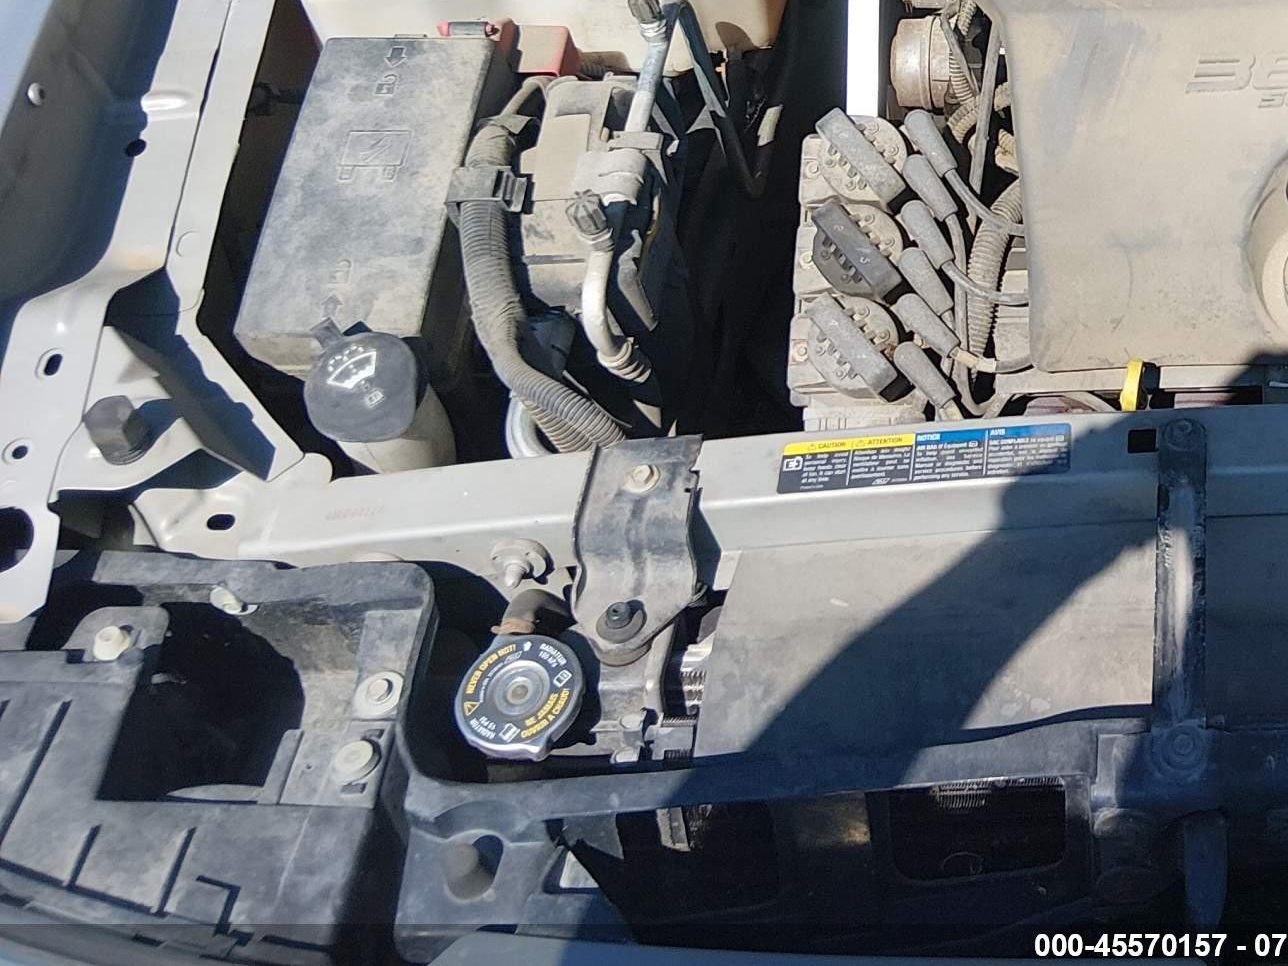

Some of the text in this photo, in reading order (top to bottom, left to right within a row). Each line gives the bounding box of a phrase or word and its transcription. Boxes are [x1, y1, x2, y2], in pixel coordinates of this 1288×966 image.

[867, 437, 902, 445] ATTENTION
[916, 433, 940, 441] NOTICE
[539, 642, 567, 666] RADIATEUR
[465, 670, 482, 695] NEVER
[479, 653, 498, 671] OPEN
[497, 643, 517, 658] HOT!
[469, 717, 497, 740] RADIATOR
